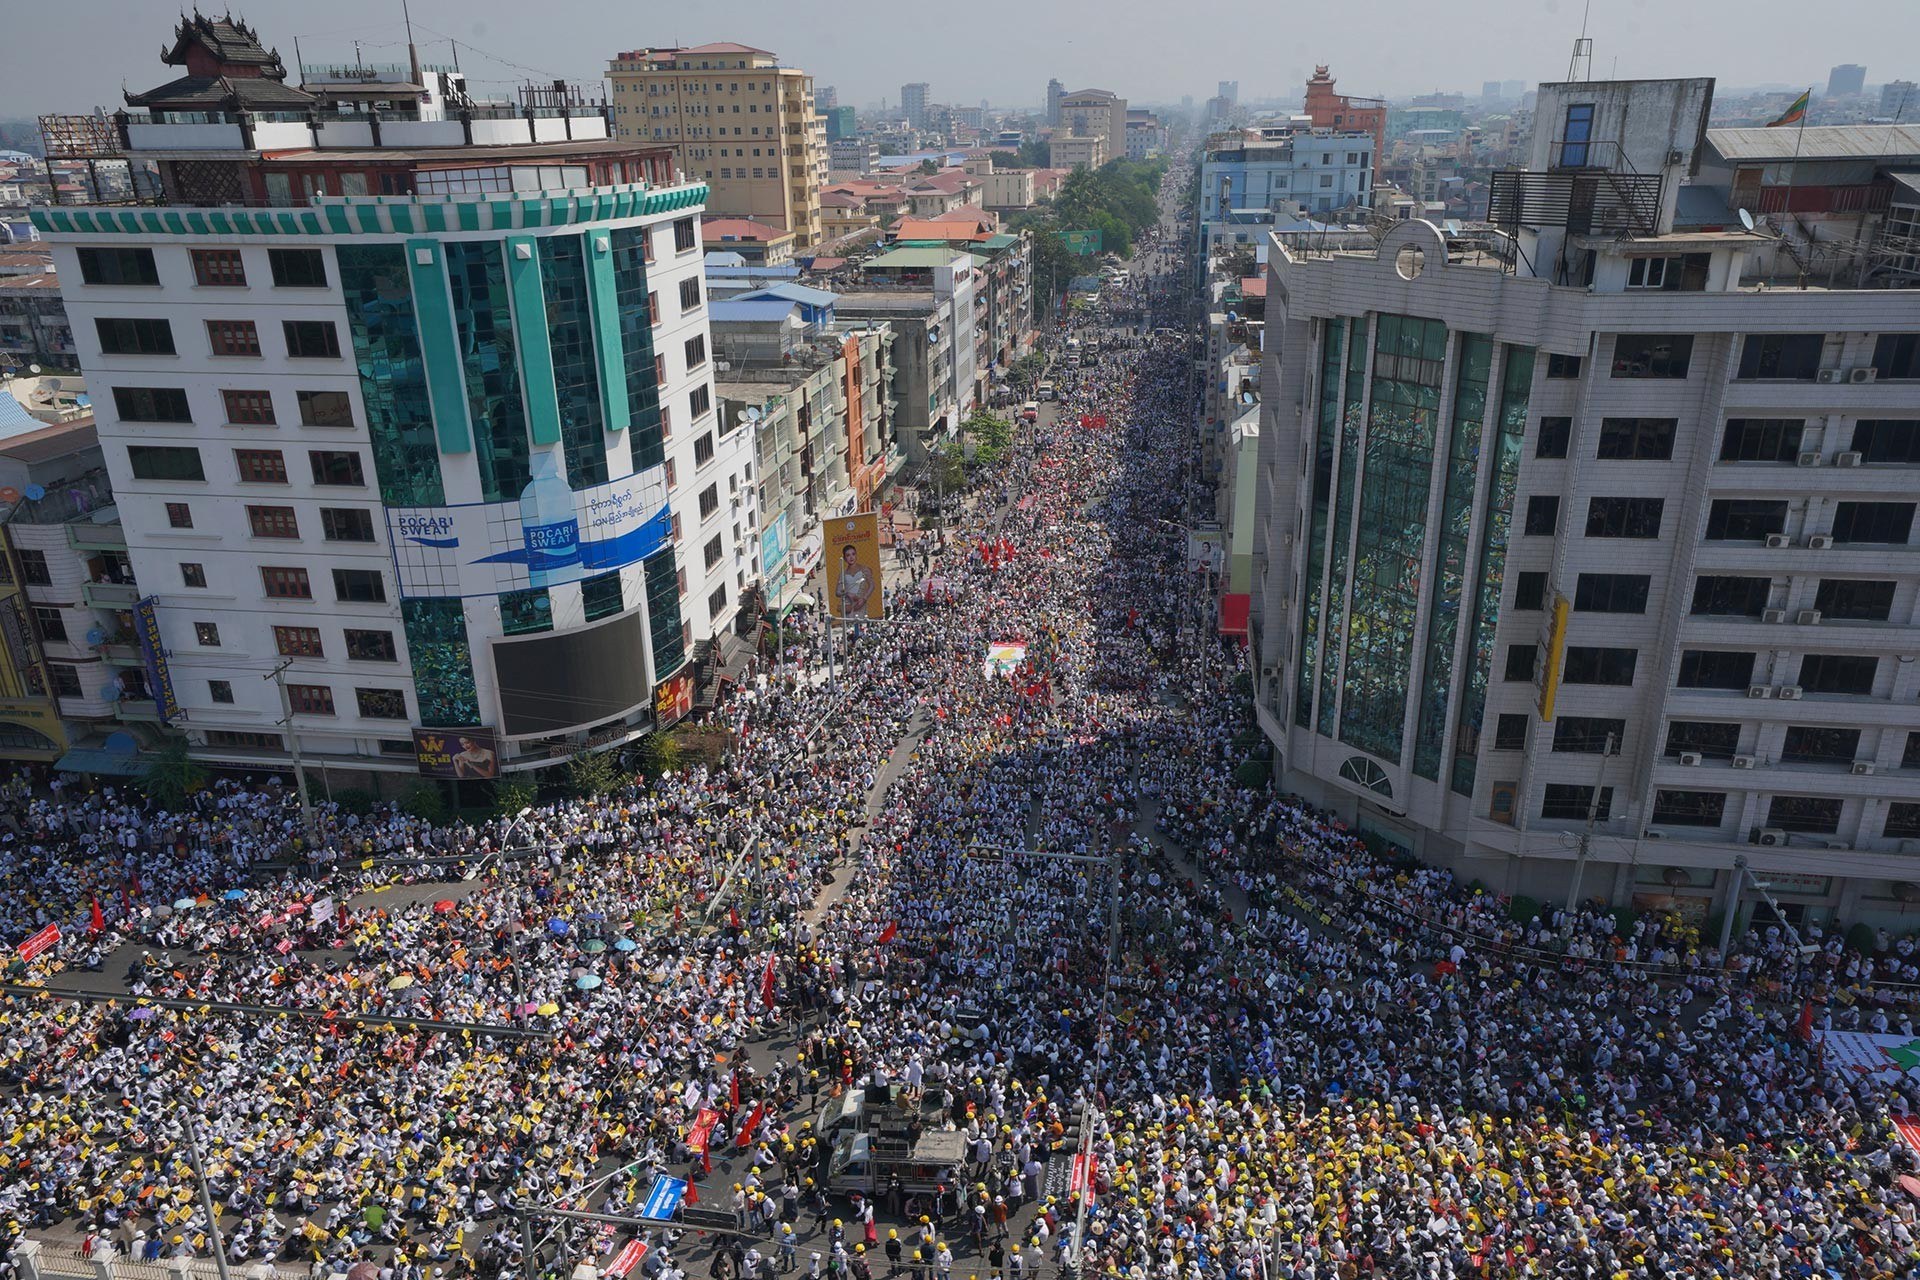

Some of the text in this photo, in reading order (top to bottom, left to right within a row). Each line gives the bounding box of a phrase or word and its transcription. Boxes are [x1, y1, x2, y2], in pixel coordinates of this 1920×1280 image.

[398, 516, 454, 527] POCARI
[400, 526, 450, 536] SWEAT
[530, 525, 573, 540] POCARI
[531, 534, 571, 548] SWEAT
